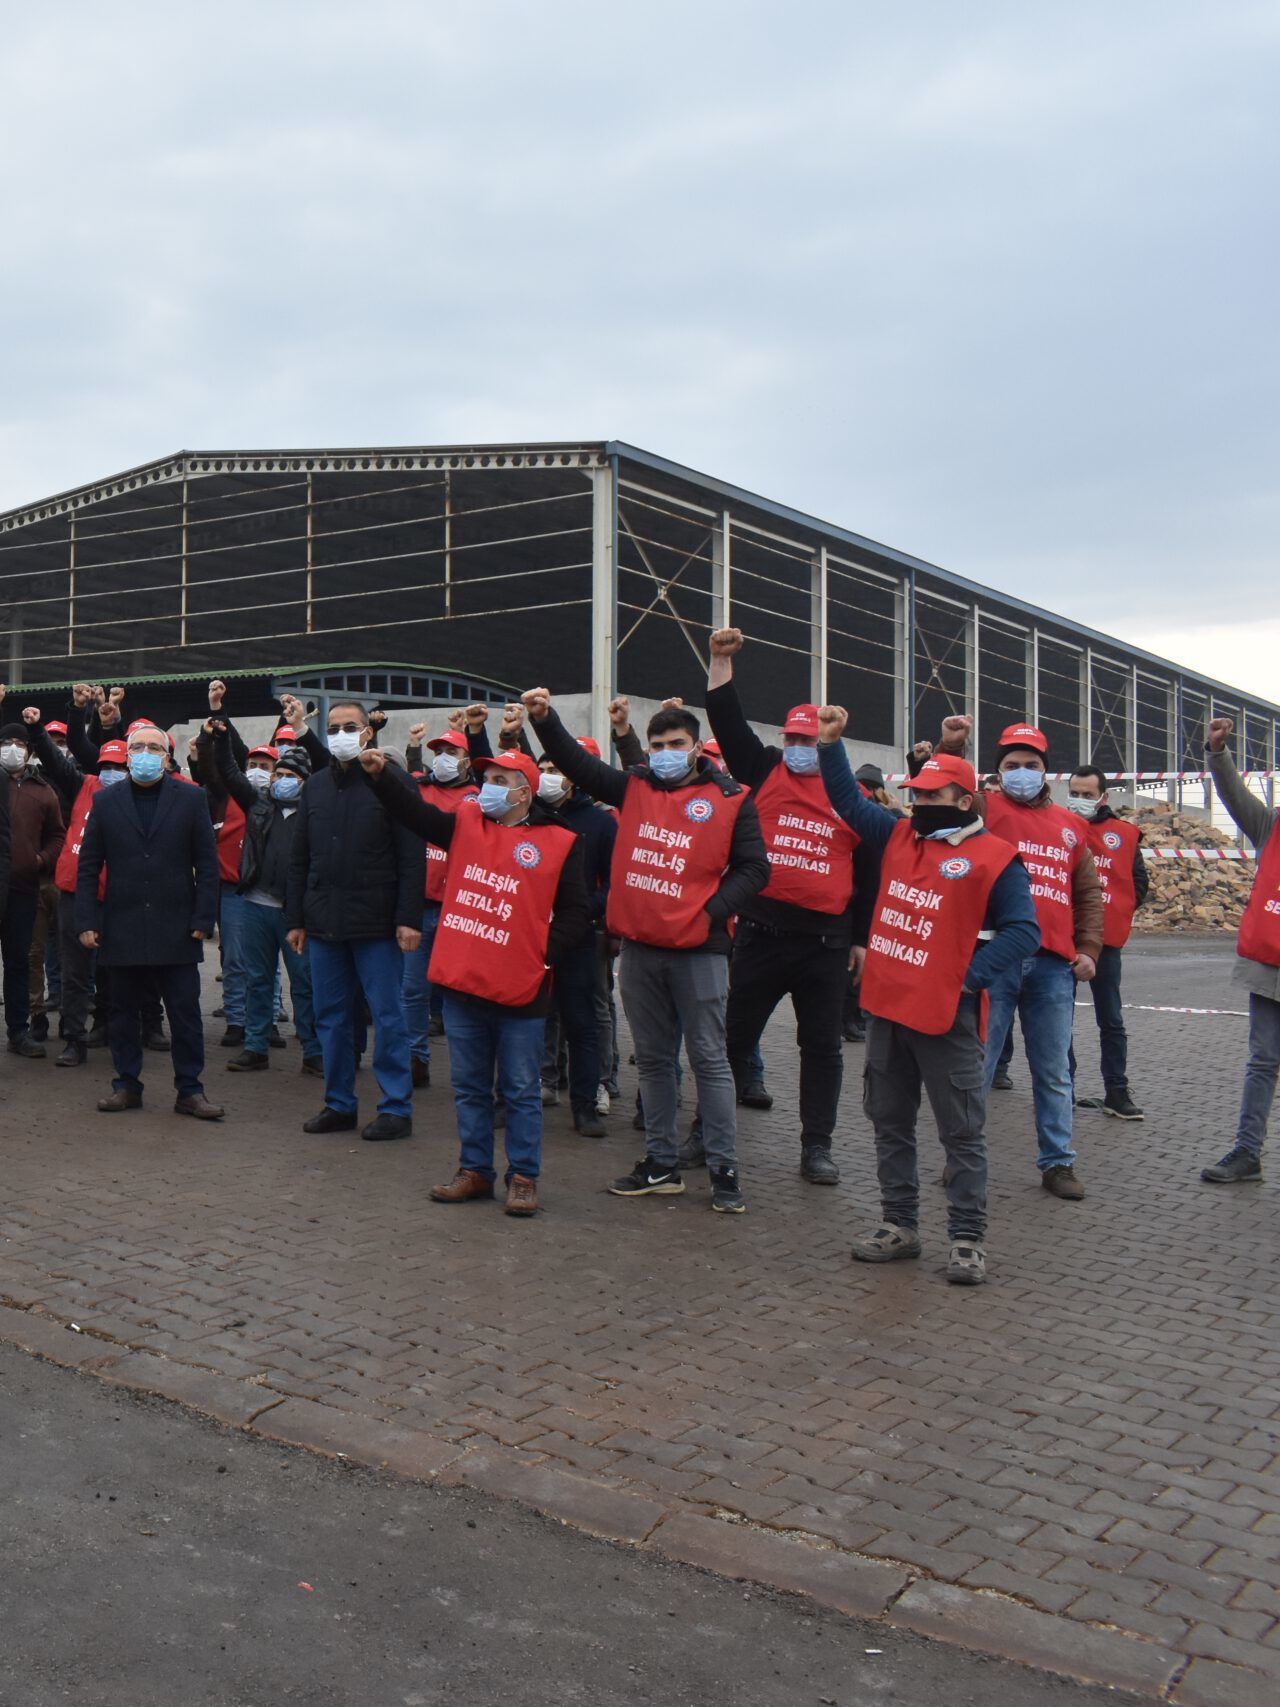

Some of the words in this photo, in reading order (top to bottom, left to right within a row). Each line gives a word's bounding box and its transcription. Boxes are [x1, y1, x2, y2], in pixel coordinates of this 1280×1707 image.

[639, 821, 693, 849] BİRLEŞİK
[778, 813, 835, 839] BİRLEŞİK
[631, 847, 686, 875] METAL-İŞ
[766, 852, 830, 875] SENDİKASI
[1018, 840, 1070, 863] BİRLEŞİK
[463, 863, 520, 895] BİRLEŞİK
[626, 872, 683, 899] SENDİKASI
[456, 889, 513, 922] METAL-İŞ
[888, 878, 943, 910] BİRLEŞİK
[1029, 883, 1069, 906] NDİKASI
[443, 913, 510, 946] SENDİKASI
[880, 906, 933, 940] METAL-İŞ
[869, 934, 929, 967] SENDİKASI
